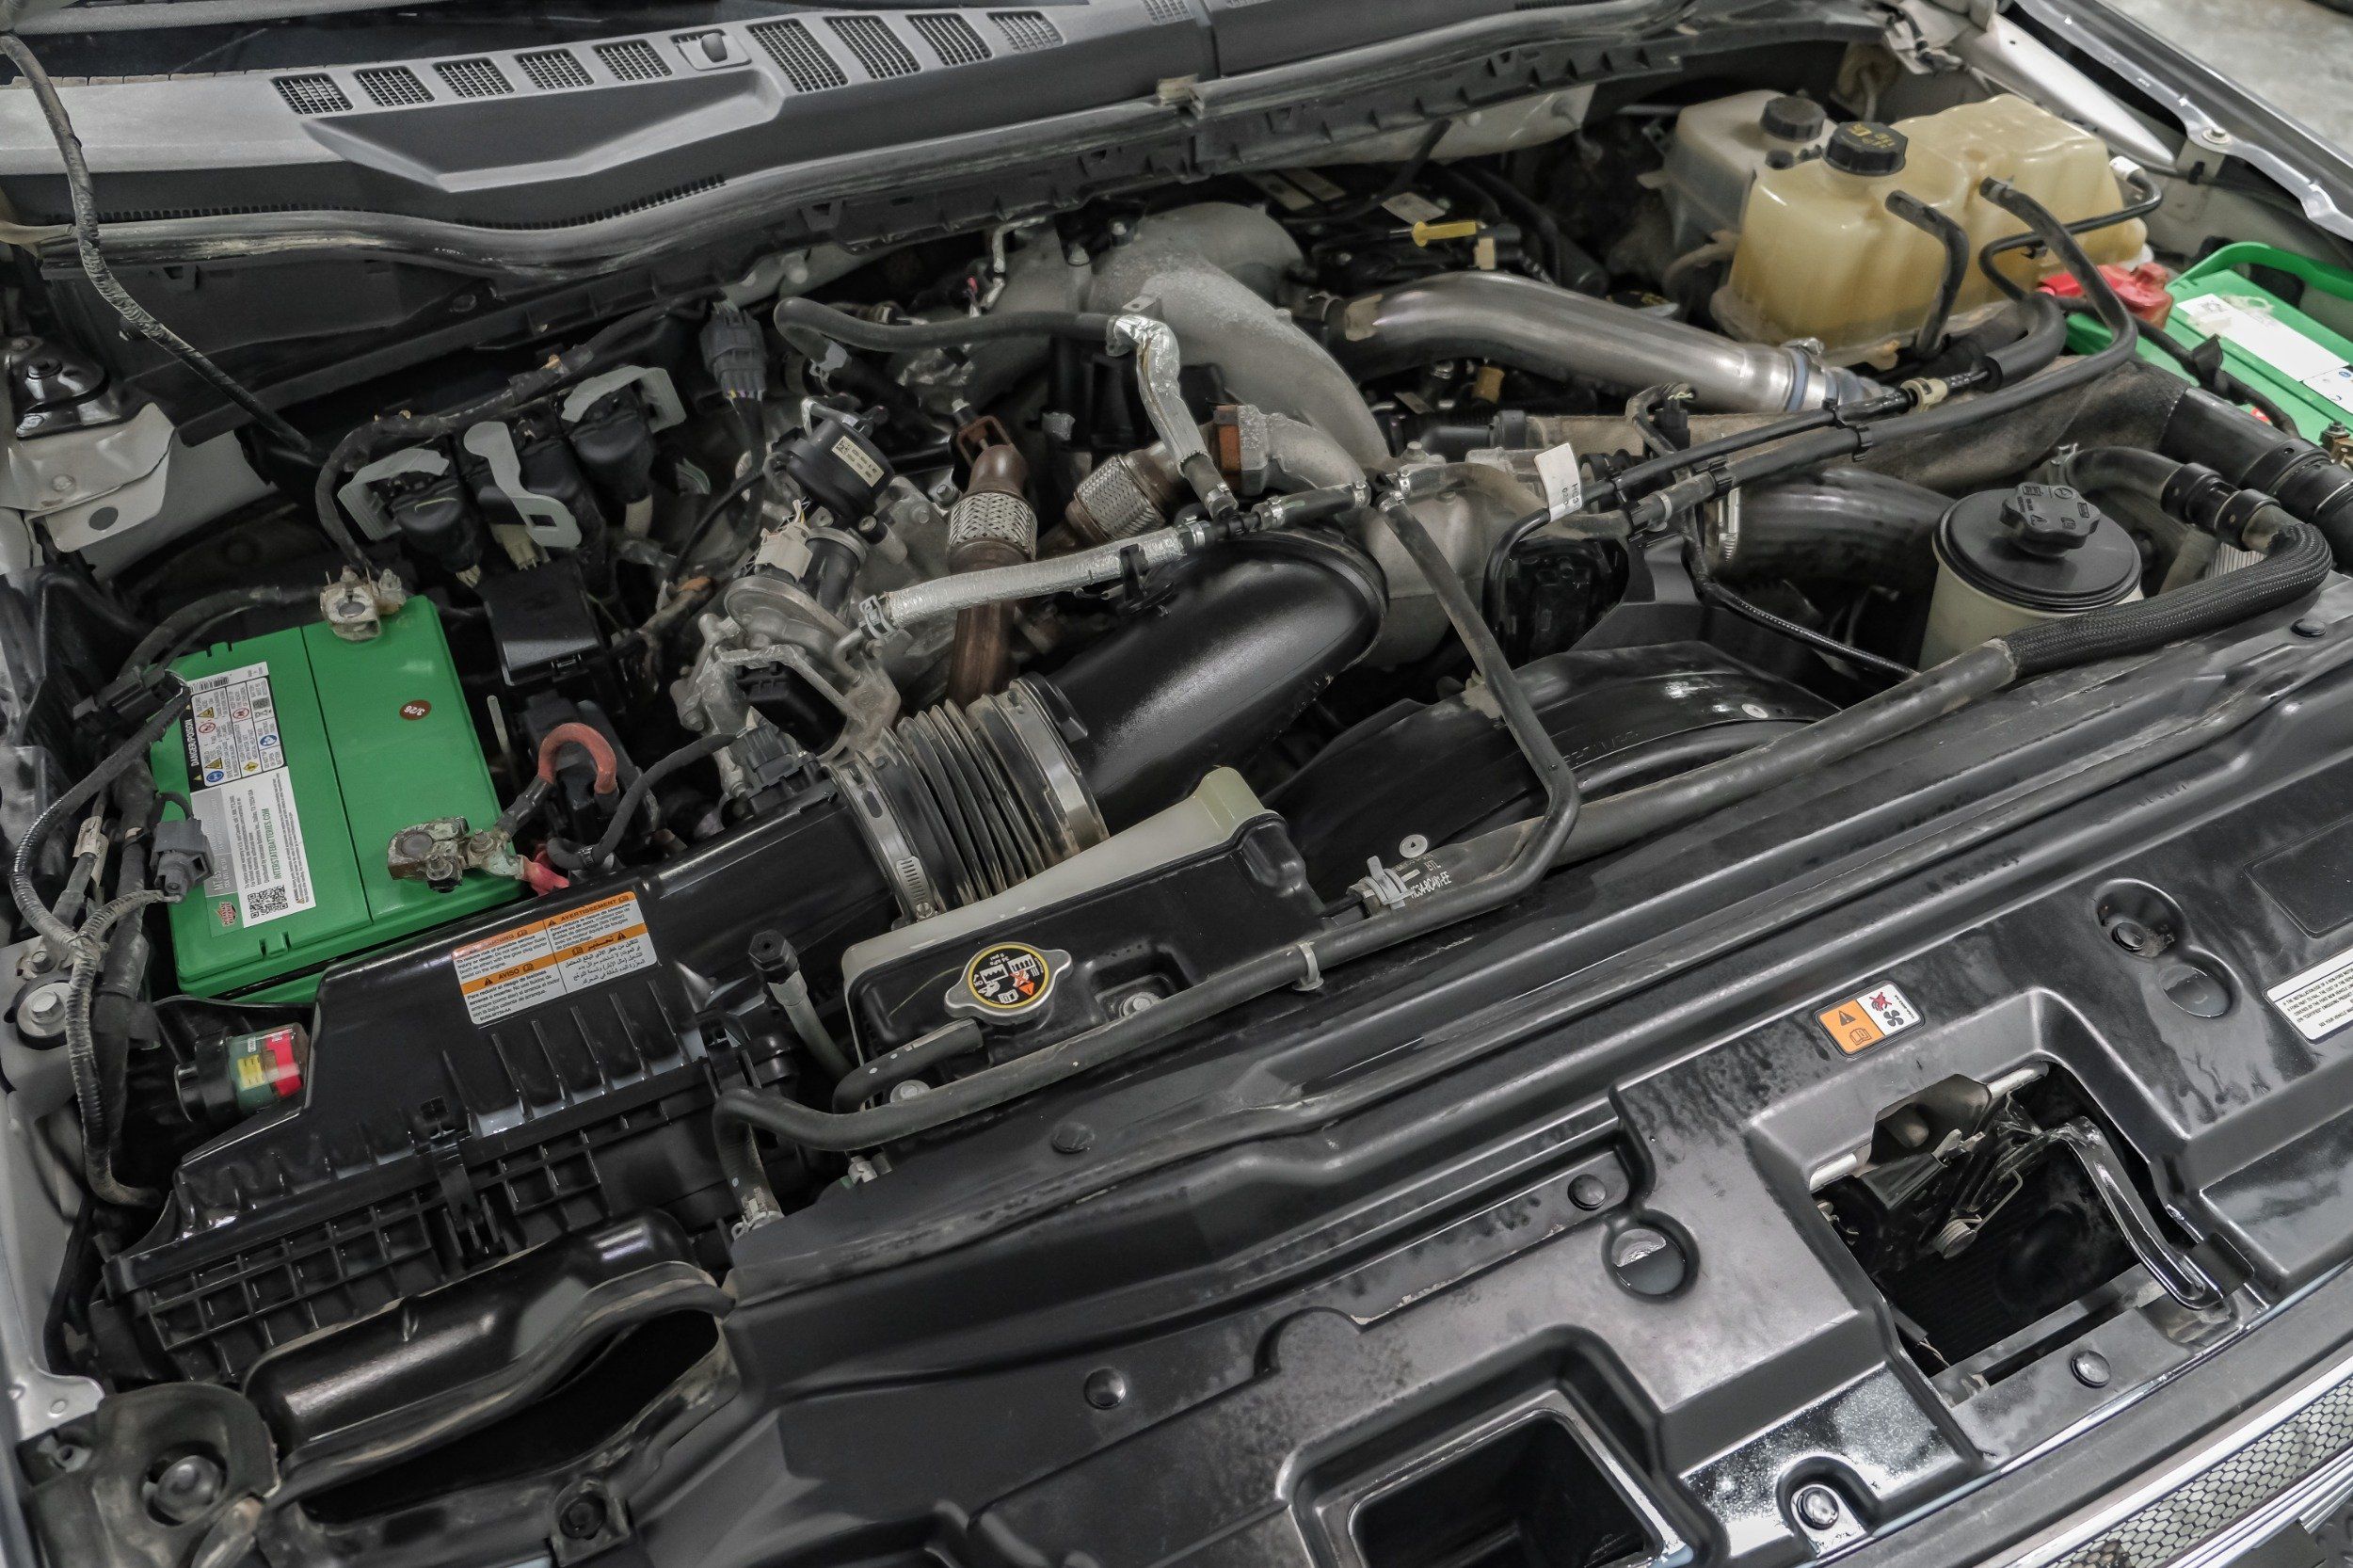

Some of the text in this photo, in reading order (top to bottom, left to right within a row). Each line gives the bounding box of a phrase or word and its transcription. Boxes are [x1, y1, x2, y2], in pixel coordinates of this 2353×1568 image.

[184, 719, 199, 766] DANGER/POISON
[262, 808, 280, 879] INTERSTATEBATTERIES.COM
[561, 899, 616, 920] AVERTISSEMENT
[498, 968, 520, 980] AVISO
